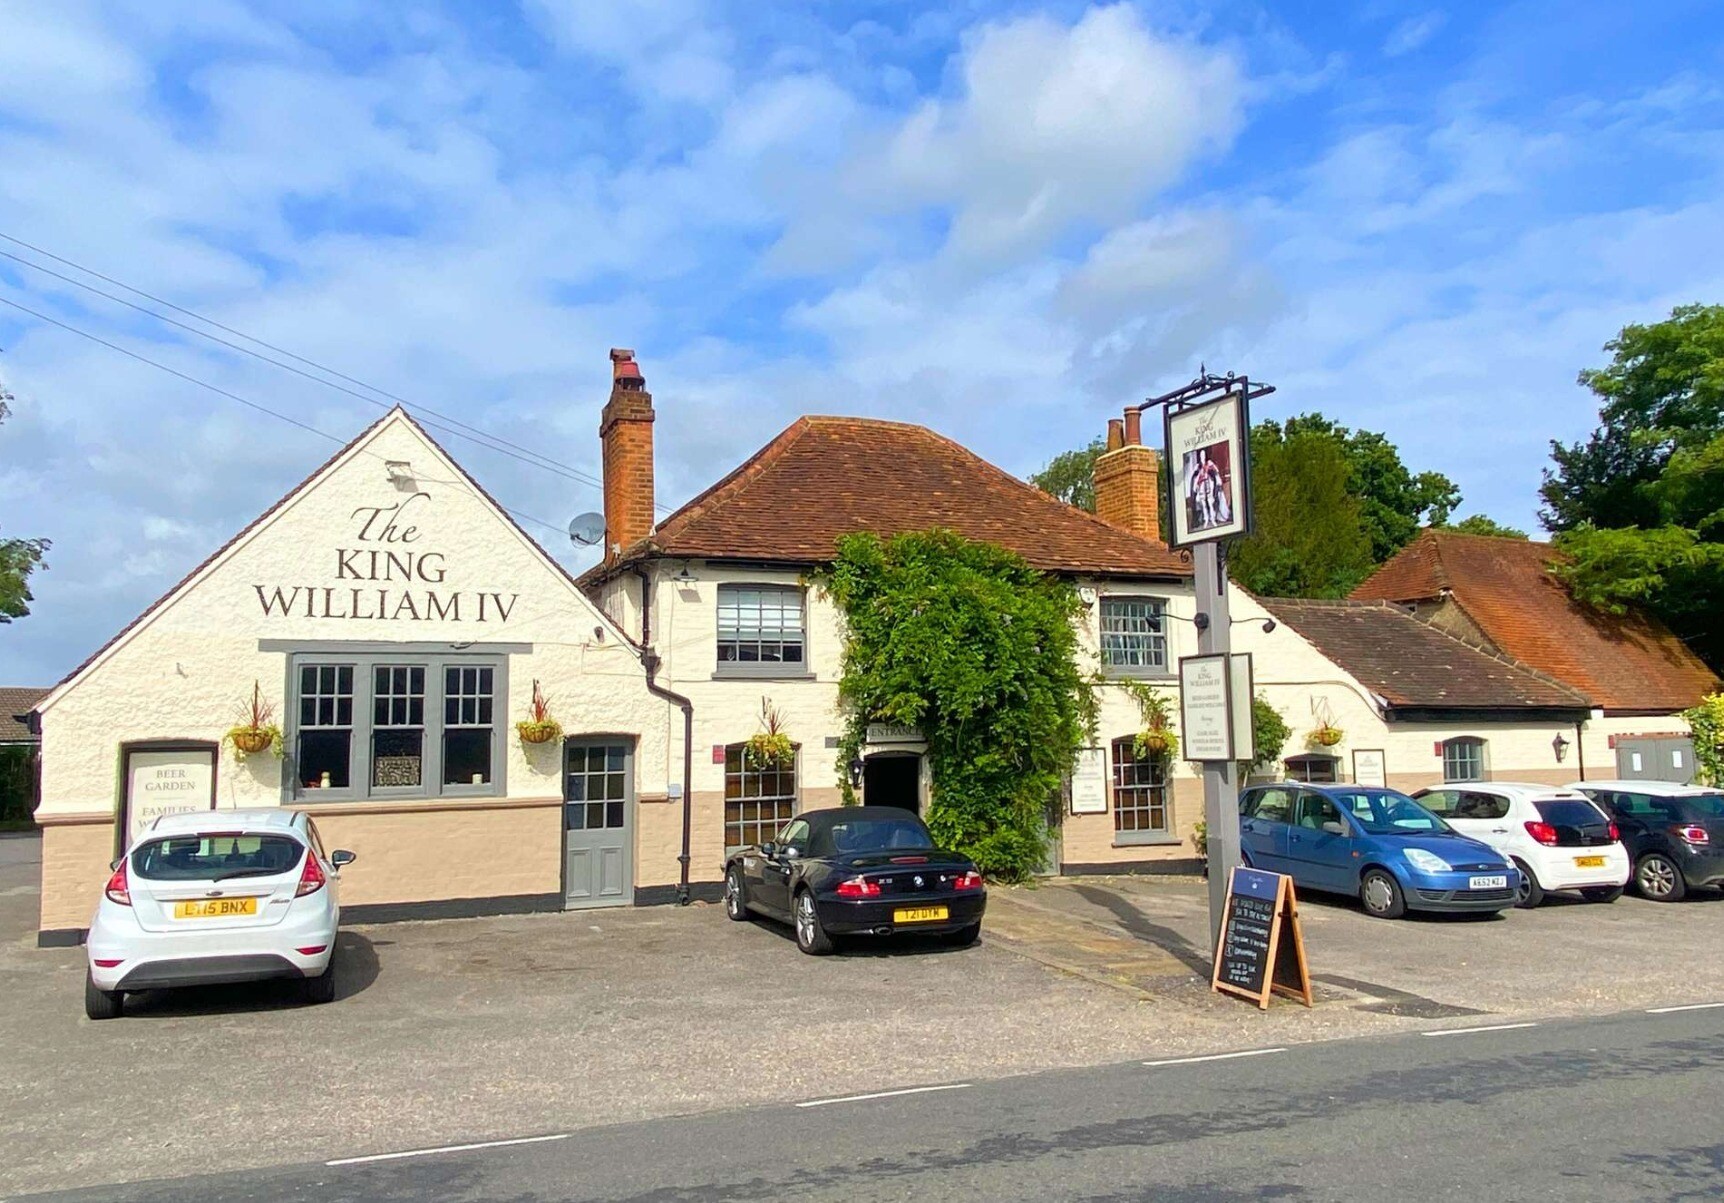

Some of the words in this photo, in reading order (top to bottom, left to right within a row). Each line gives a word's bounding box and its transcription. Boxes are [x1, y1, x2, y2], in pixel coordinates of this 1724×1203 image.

[1194, 422, 1214, 435] KING
[1183, 430, 1217, 447] WILLIAM
[350, 492, 431, 543] The
[335, 548, 447, 583] KING
[252, 584, 462, 622] WILLIAM
[475, 592, 520, 623] IV
[156, 769, 186, 779] BEER
[145, 781, 197, 791] GARDEN
[142, 805, 197, 817] FAMILIES
[220, 900, 248, 914] BNX
